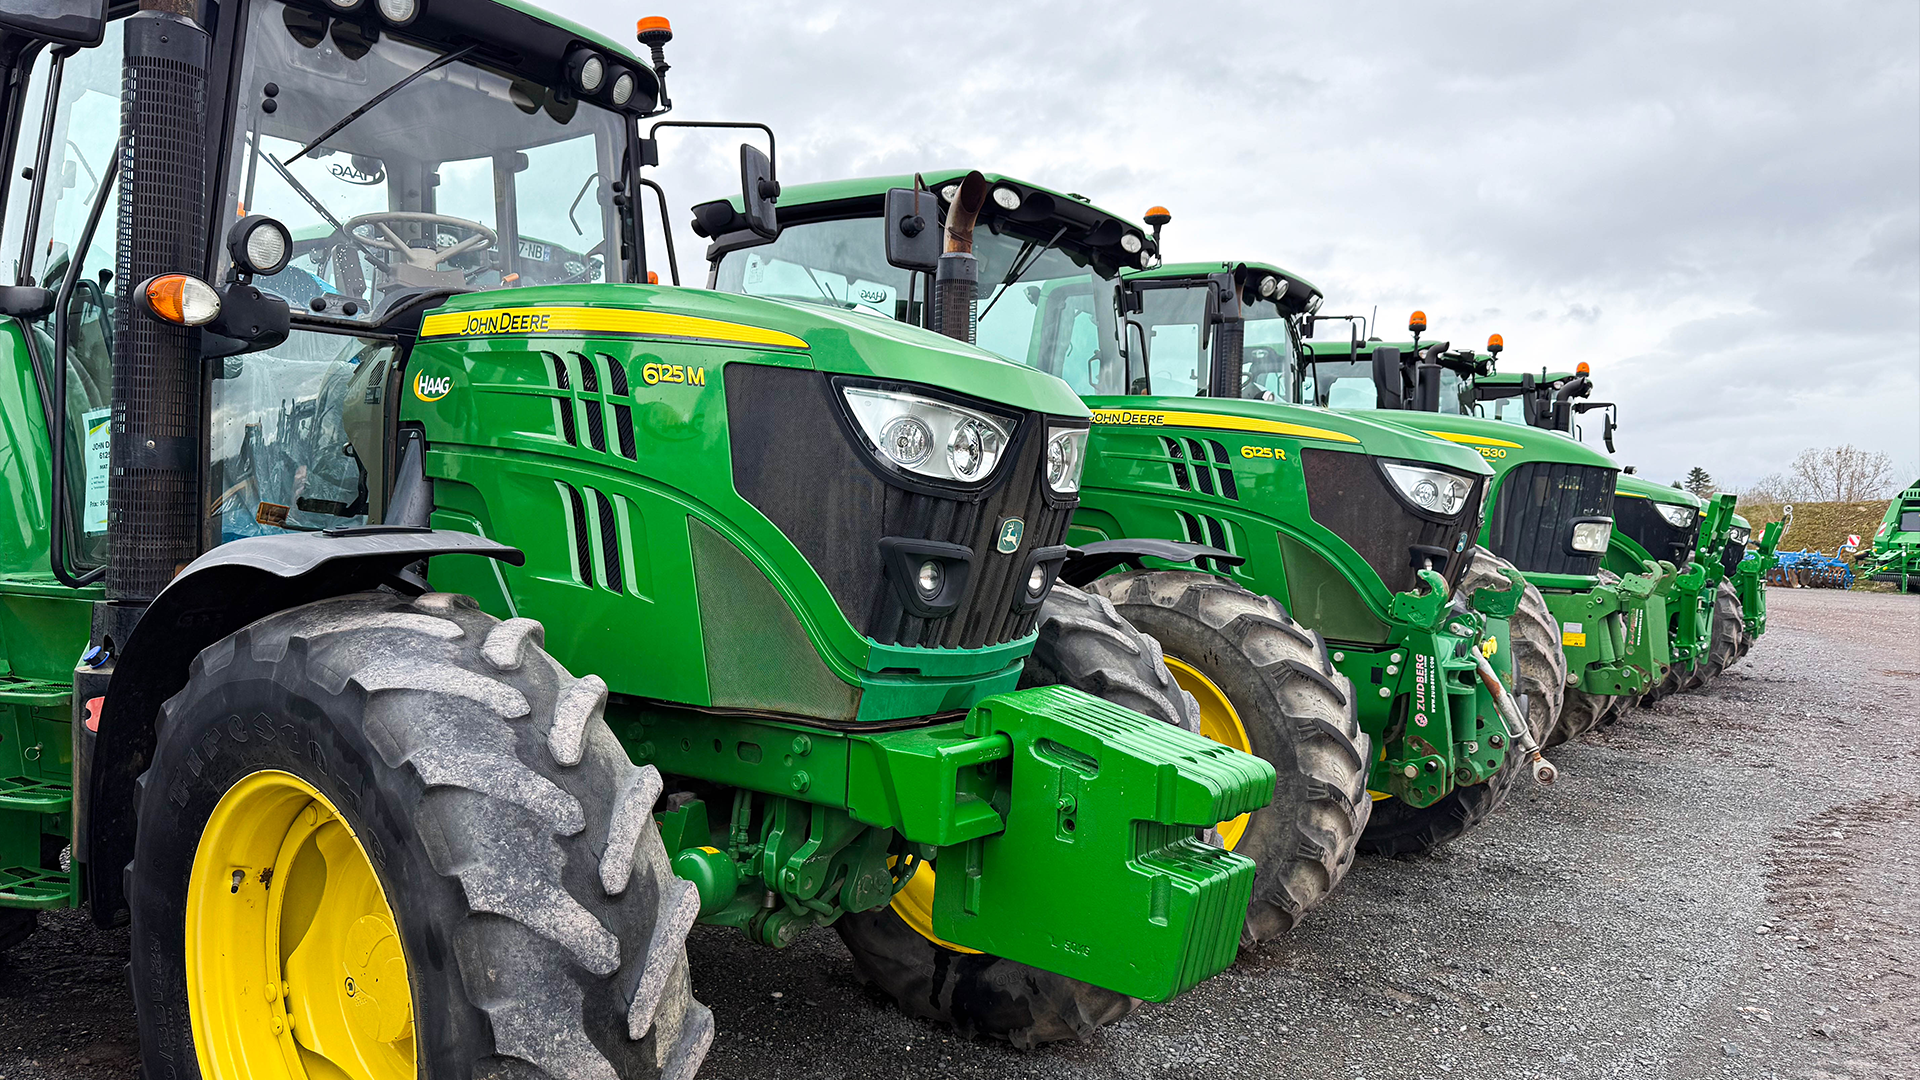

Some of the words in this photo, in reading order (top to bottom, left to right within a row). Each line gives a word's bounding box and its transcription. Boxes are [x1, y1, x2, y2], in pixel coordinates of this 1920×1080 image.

[462, 315, 499, 334] JOHN
[499, 312, 551, 331] DEERE
[417, 374, 451, 395] HAAG
[642, 362, 686, 387] 6125
[686, 365, 706, 387] M
[1121, 411, 1165, 425] DEERE
[1240, 445, 1274, 460] 6125
[1274, 447, 1288, 461] R
[1474, 446, 1508, 460] 7530
[1415, 653, 1426, 712] ZUIDBERG
